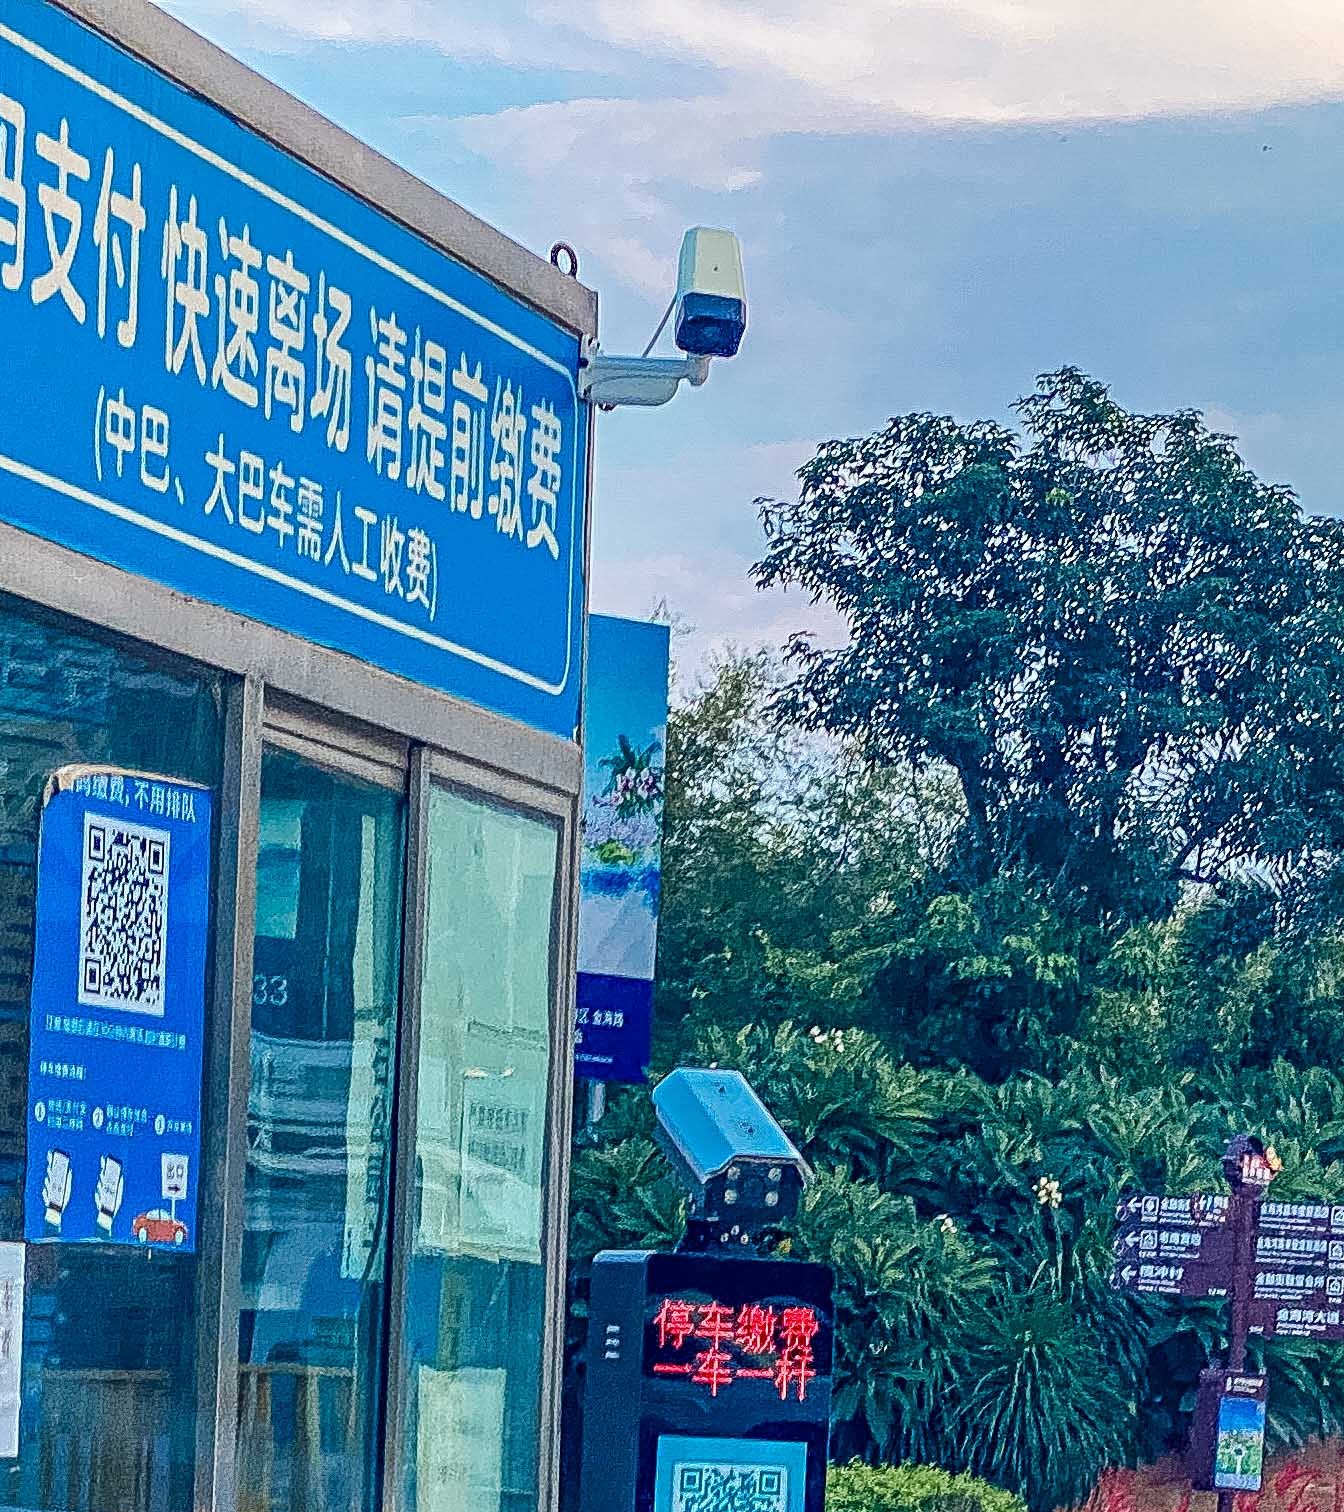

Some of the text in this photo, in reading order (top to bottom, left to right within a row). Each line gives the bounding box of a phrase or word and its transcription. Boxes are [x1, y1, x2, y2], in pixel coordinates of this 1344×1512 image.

[162, 183, 354, 455] 快速离场
[363, 304, 563, 563] 请提前缴费
[653, 1298, 820, 1353] 停车缴费
[652, 1347, 817, 1401] 一车一杆
